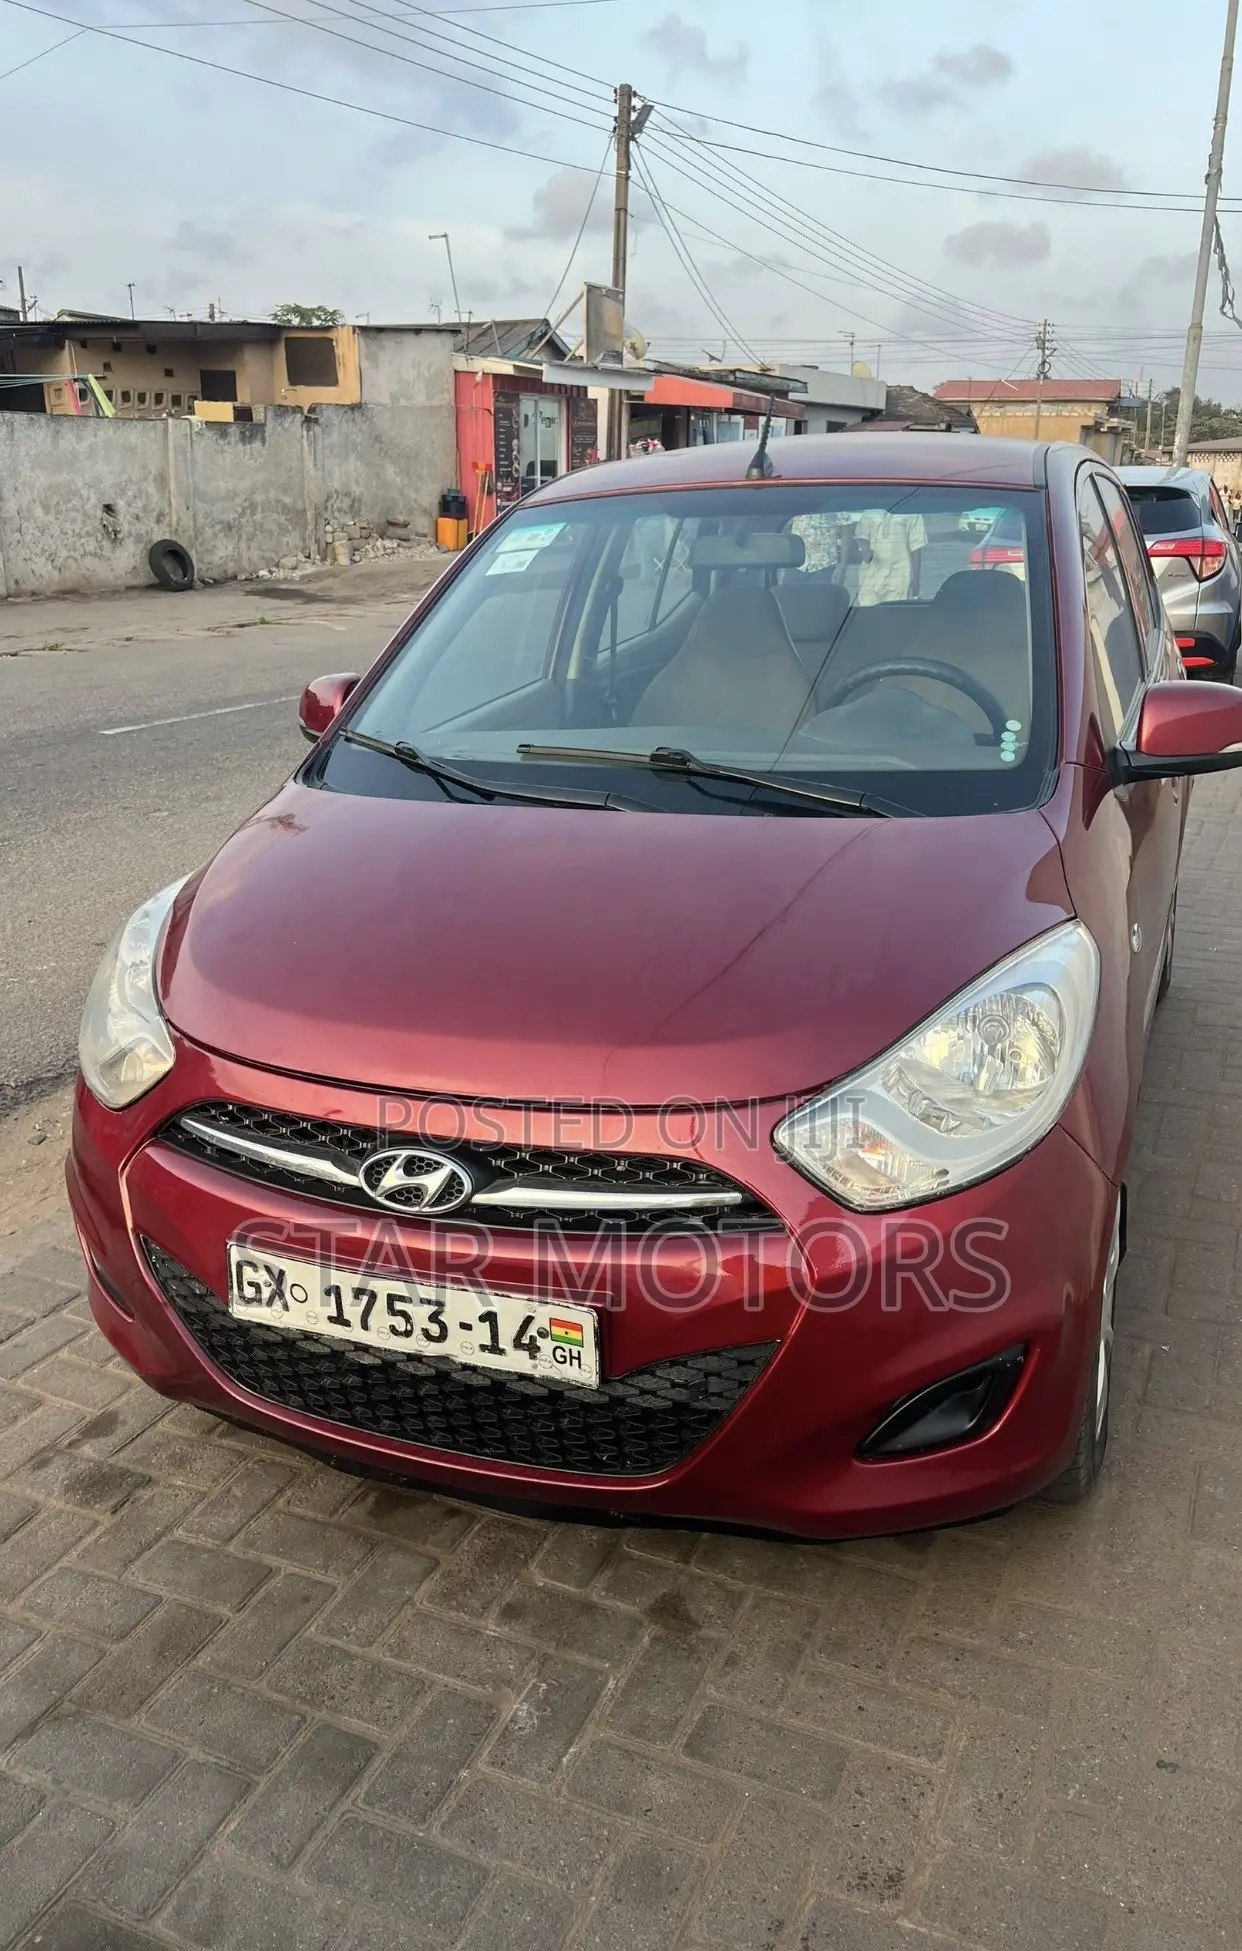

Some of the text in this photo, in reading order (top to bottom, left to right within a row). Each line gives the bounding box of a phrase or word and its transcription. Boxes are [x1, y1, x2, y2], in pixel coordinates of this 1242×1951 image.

[235, 1259, 541, 1361] GX 1753-14
[552, 1345, 582, 1369] GH
